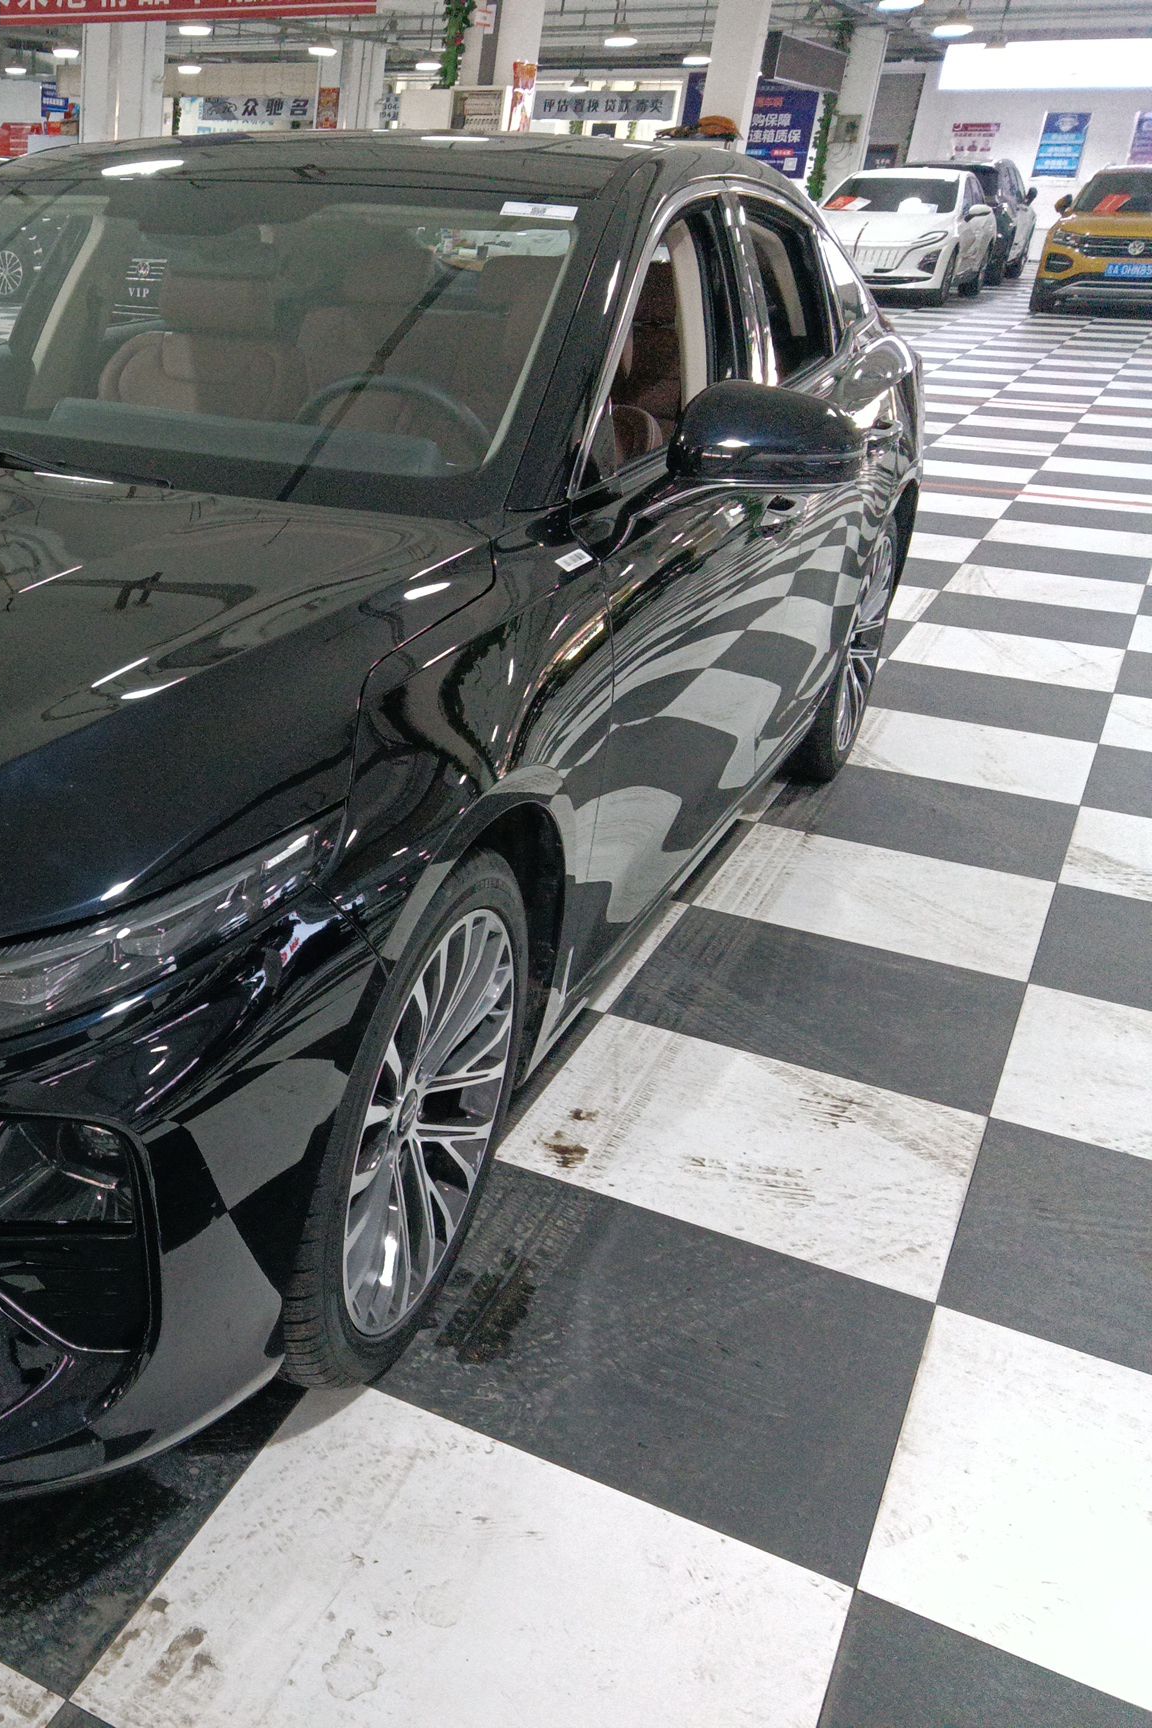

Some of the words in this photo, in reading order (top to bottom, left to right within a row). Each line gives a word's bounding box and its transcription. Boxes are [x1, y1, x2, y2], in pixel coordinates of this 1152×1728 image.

[241, 98, 309, 116] 众驰名
[752, 113, 792, 127] 购保障
[128, 287, 150, 298] VIP
